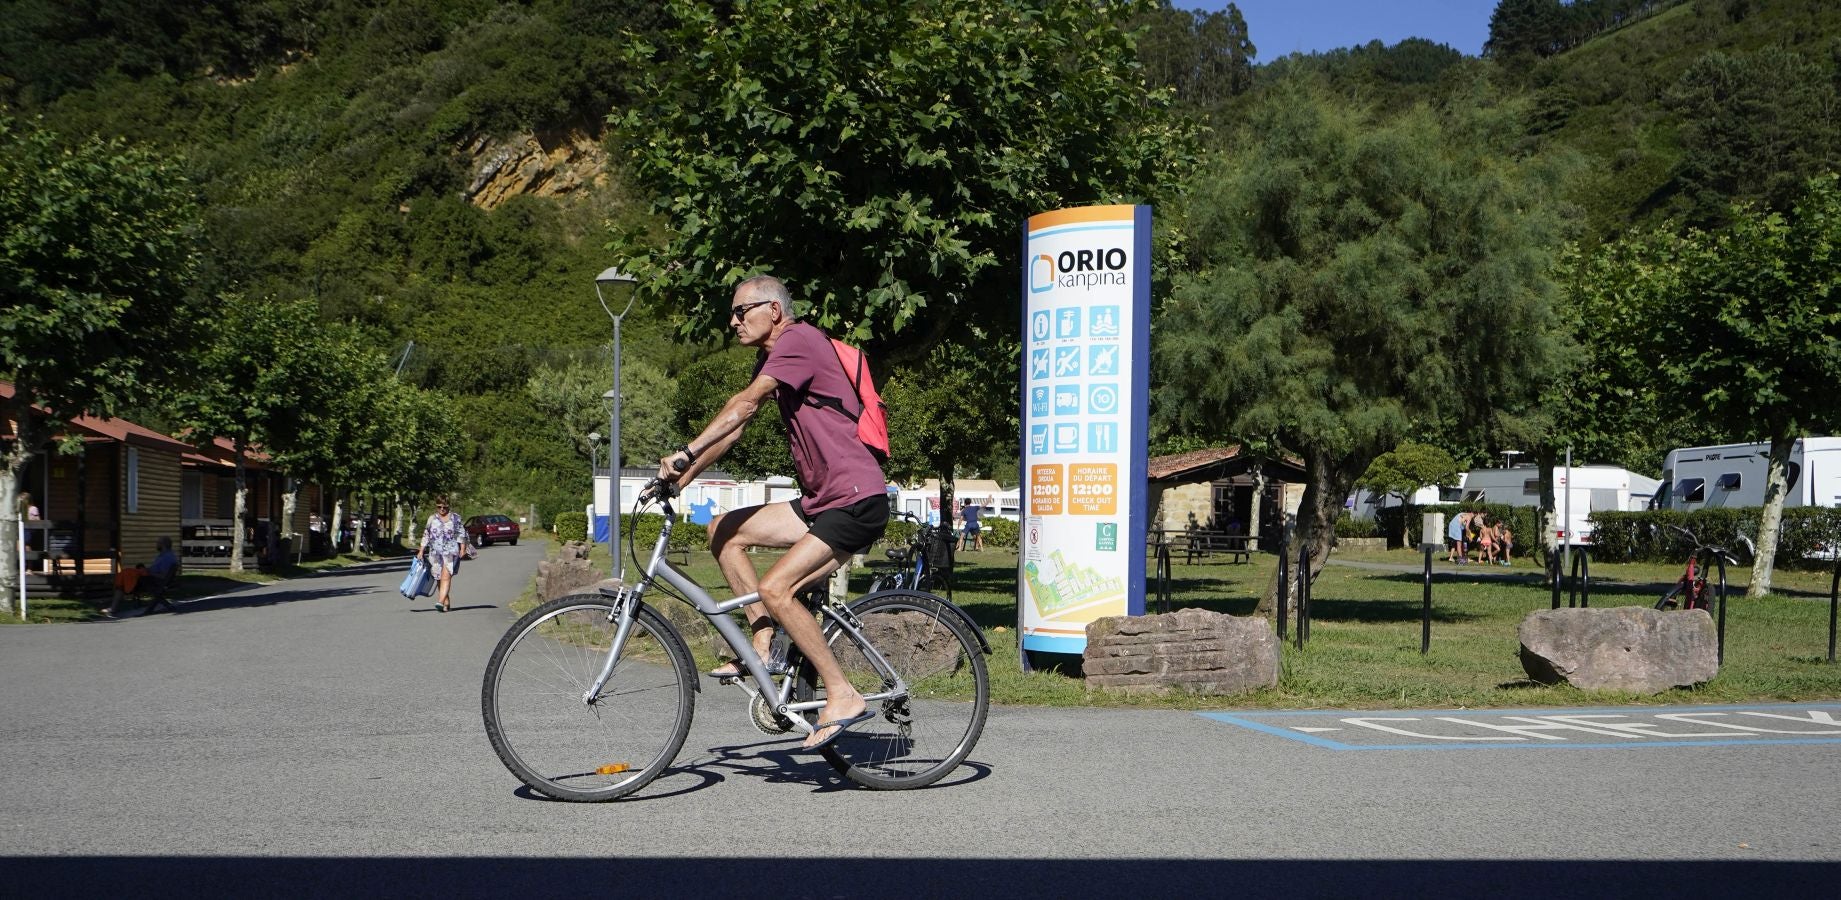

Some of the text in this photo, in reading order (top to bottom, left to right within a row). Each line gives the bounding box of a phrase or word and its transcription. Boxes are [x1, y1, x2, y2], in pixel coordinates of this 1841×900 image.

[1058, 247, 1127, 273] ORIO
[1058, 271, 1126, 291] kanpina
[1096, 393, 1110, 404] 10
[1078, 467, 1107, 475] HORAIRE
[1032, 484, 1060, 496] 12:00
[1072, 483, 1113, 495] 12:00
